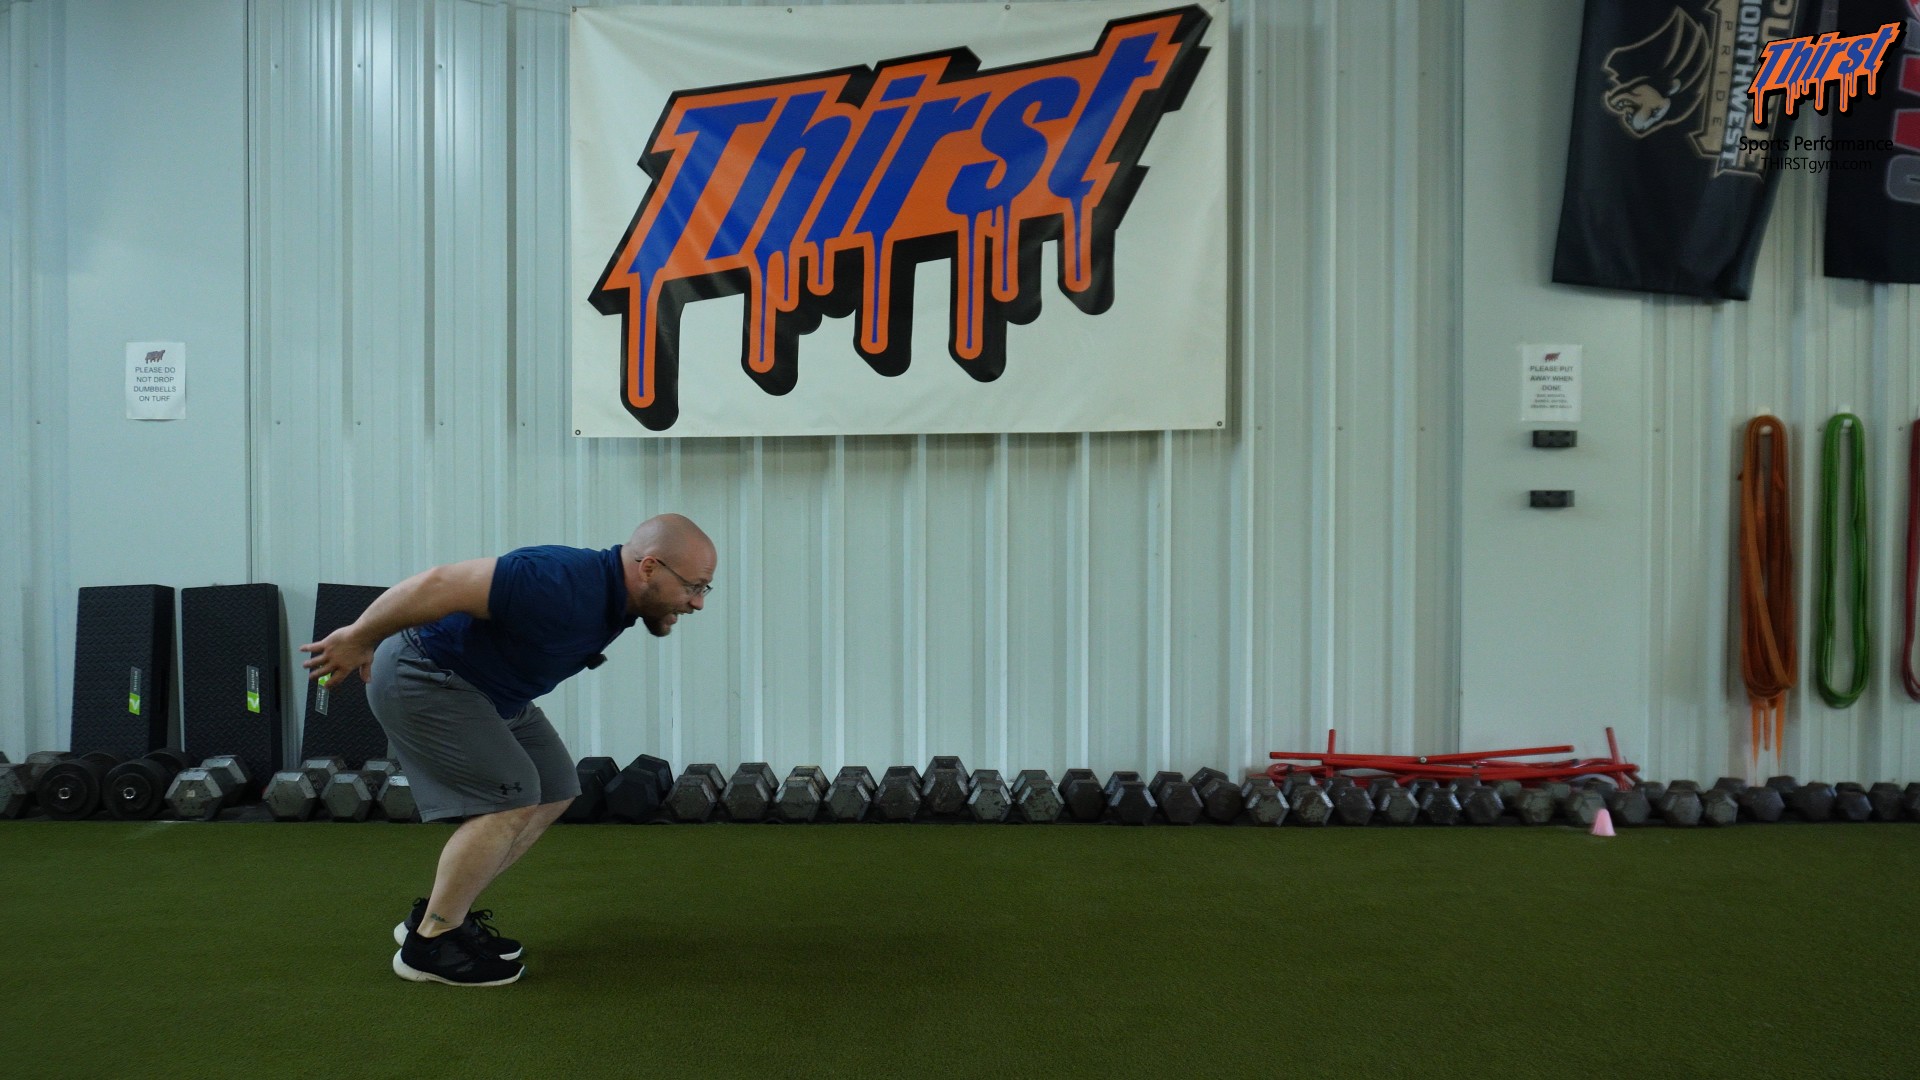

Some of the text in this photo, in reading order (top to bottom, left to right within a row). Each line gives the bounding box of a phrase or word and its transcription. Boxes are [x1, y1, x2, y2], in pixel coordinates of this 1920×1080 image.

[1712, 20, 1733, 127] PRIDE
[1720, 0, 1764, 168] ORTHWEST
[622, 27, 1165, 390] Thirst
[135, 366, 163, 374] PLEASE
